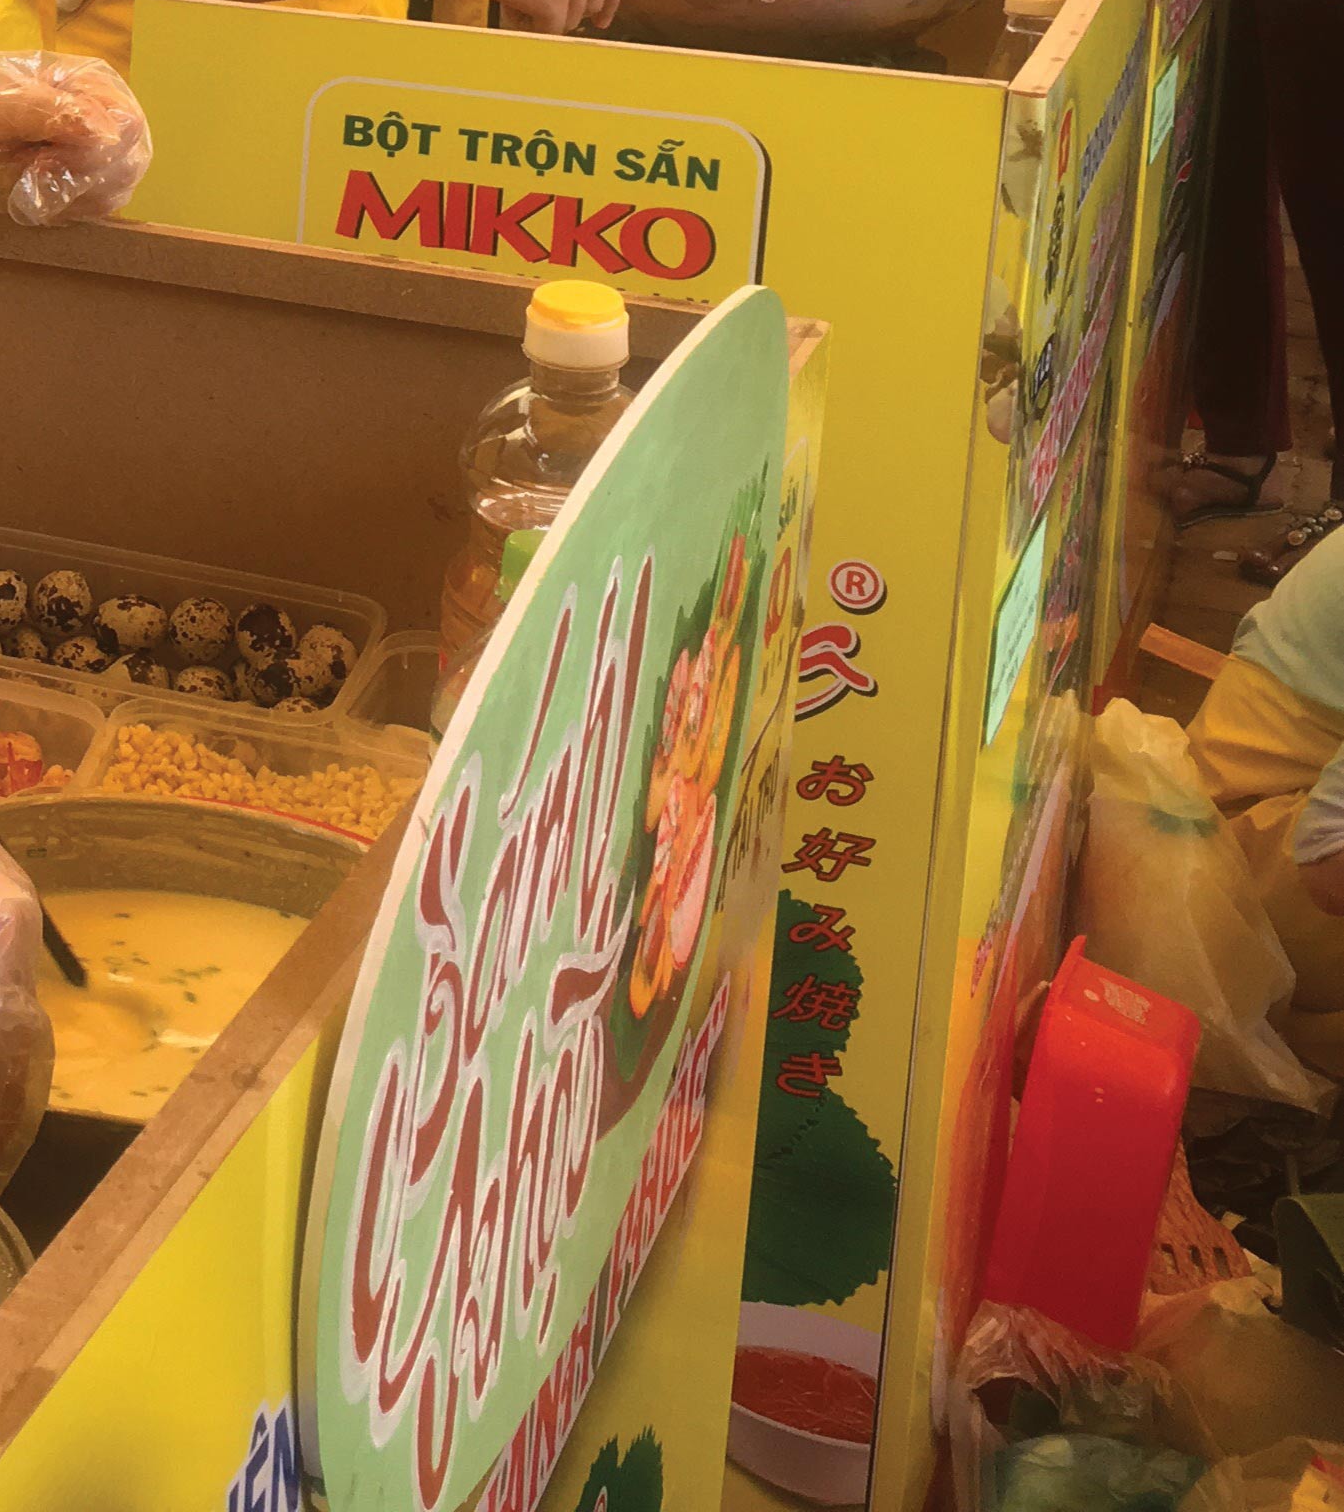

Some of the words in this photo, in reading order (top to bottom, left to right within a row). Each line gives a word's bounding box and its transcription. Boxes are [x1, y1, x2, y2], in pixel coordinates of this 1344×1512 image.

[342, 110, 441, 158] BỘT
[458, 126, 597, 178] TRỘN
[334, 169, 717, 281] MIKKO
[773, 754, 877, 1098] お好み焼き
